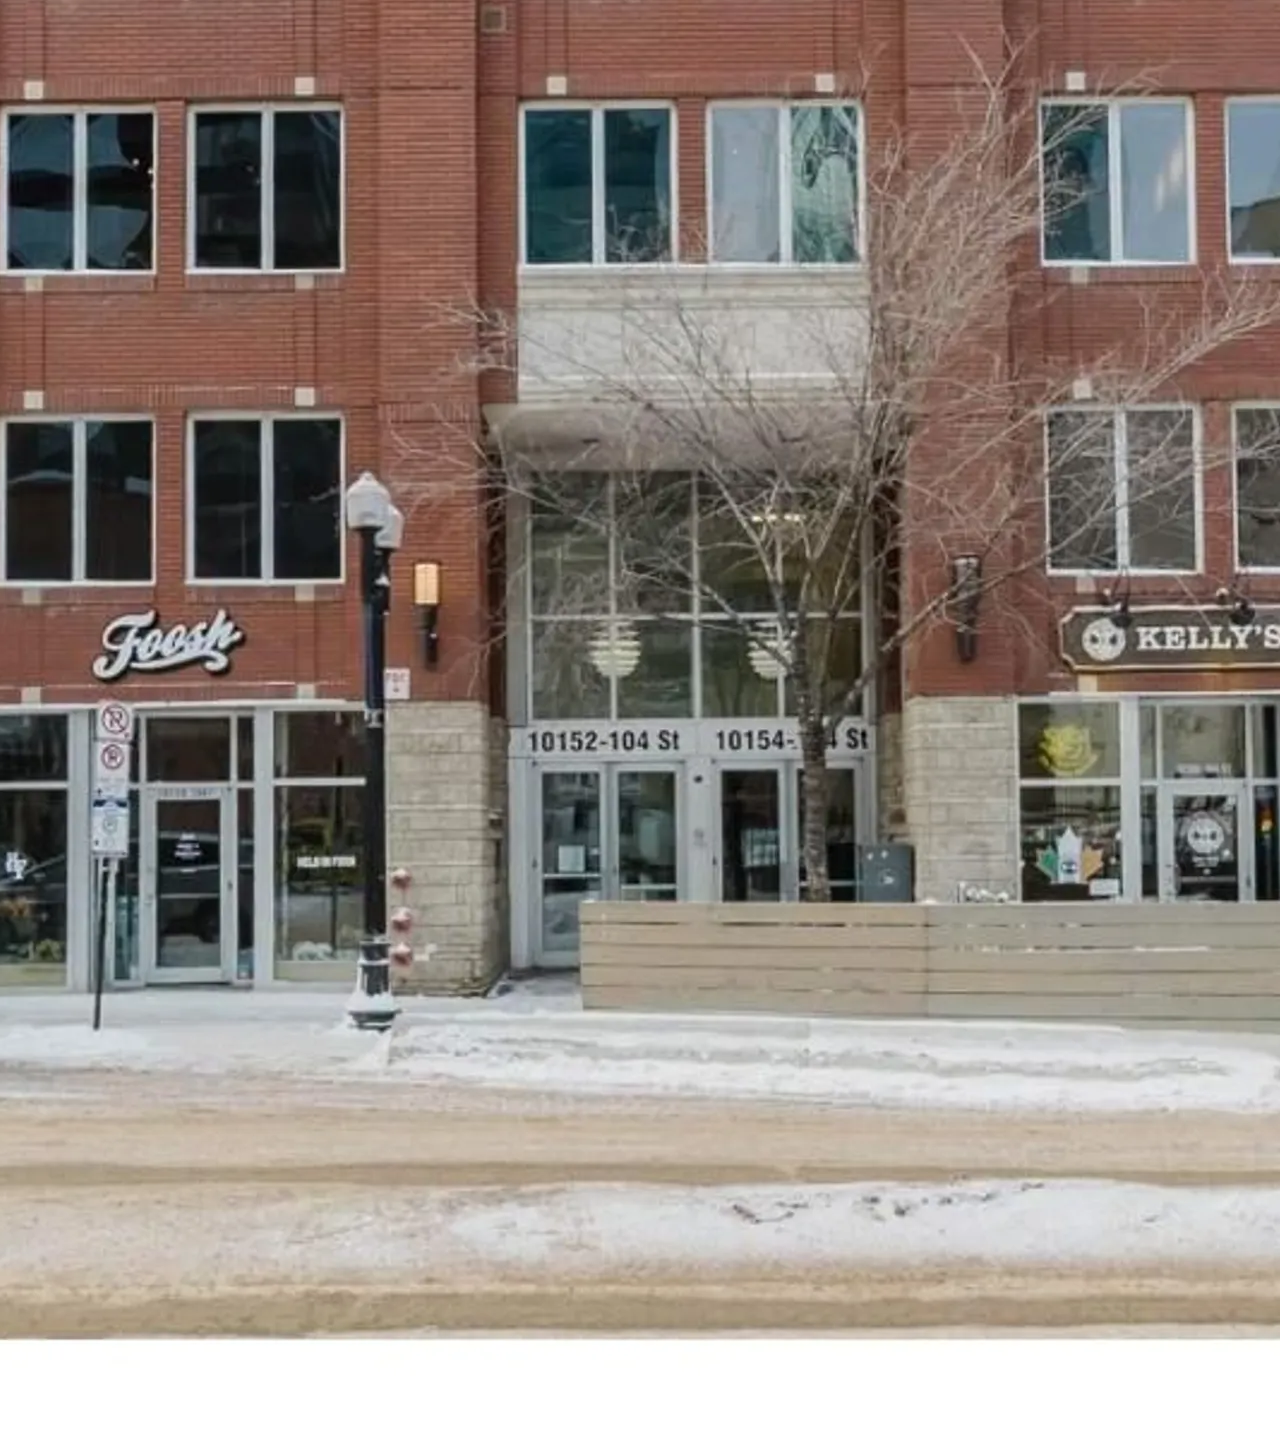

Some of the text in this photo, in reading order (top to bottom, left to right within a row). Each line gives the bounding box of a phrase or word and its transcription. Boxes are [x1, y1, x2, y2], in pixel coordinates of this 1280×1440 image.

[93, 609, 244, 678] Foosh
[529, 729, 679, 752] 10152-104 St
[846, 727, 869, 750] St
